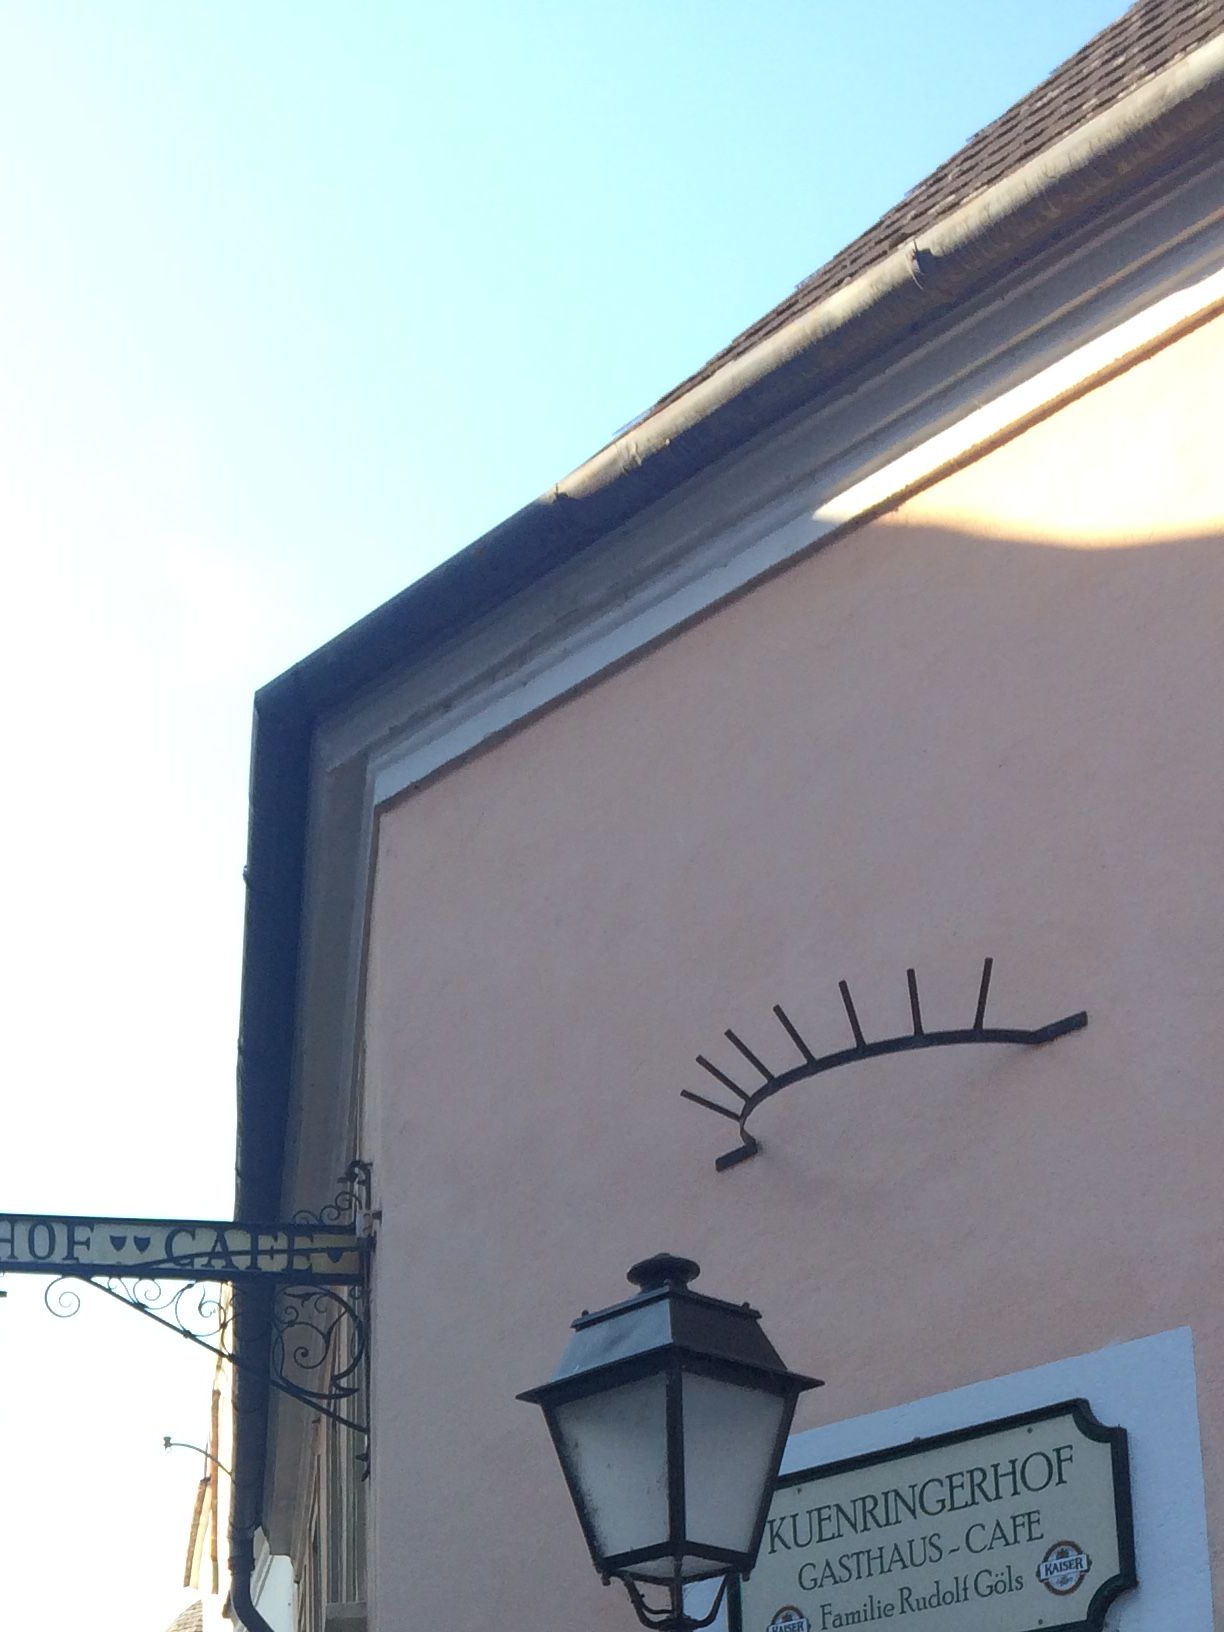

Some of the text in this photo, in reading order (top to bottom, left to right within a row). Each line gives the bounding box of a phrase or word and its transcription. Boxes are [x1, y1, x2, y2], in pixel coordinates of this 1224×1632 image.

[164, 1226, 315, 1273] CAFE
[767, 1445, 1074, 1555] KUENRINGERHOF
[1044, 1557, 1084, 1577] KAISER
[819, 1565, 1025, 1631] Familie Rudolf Göls
